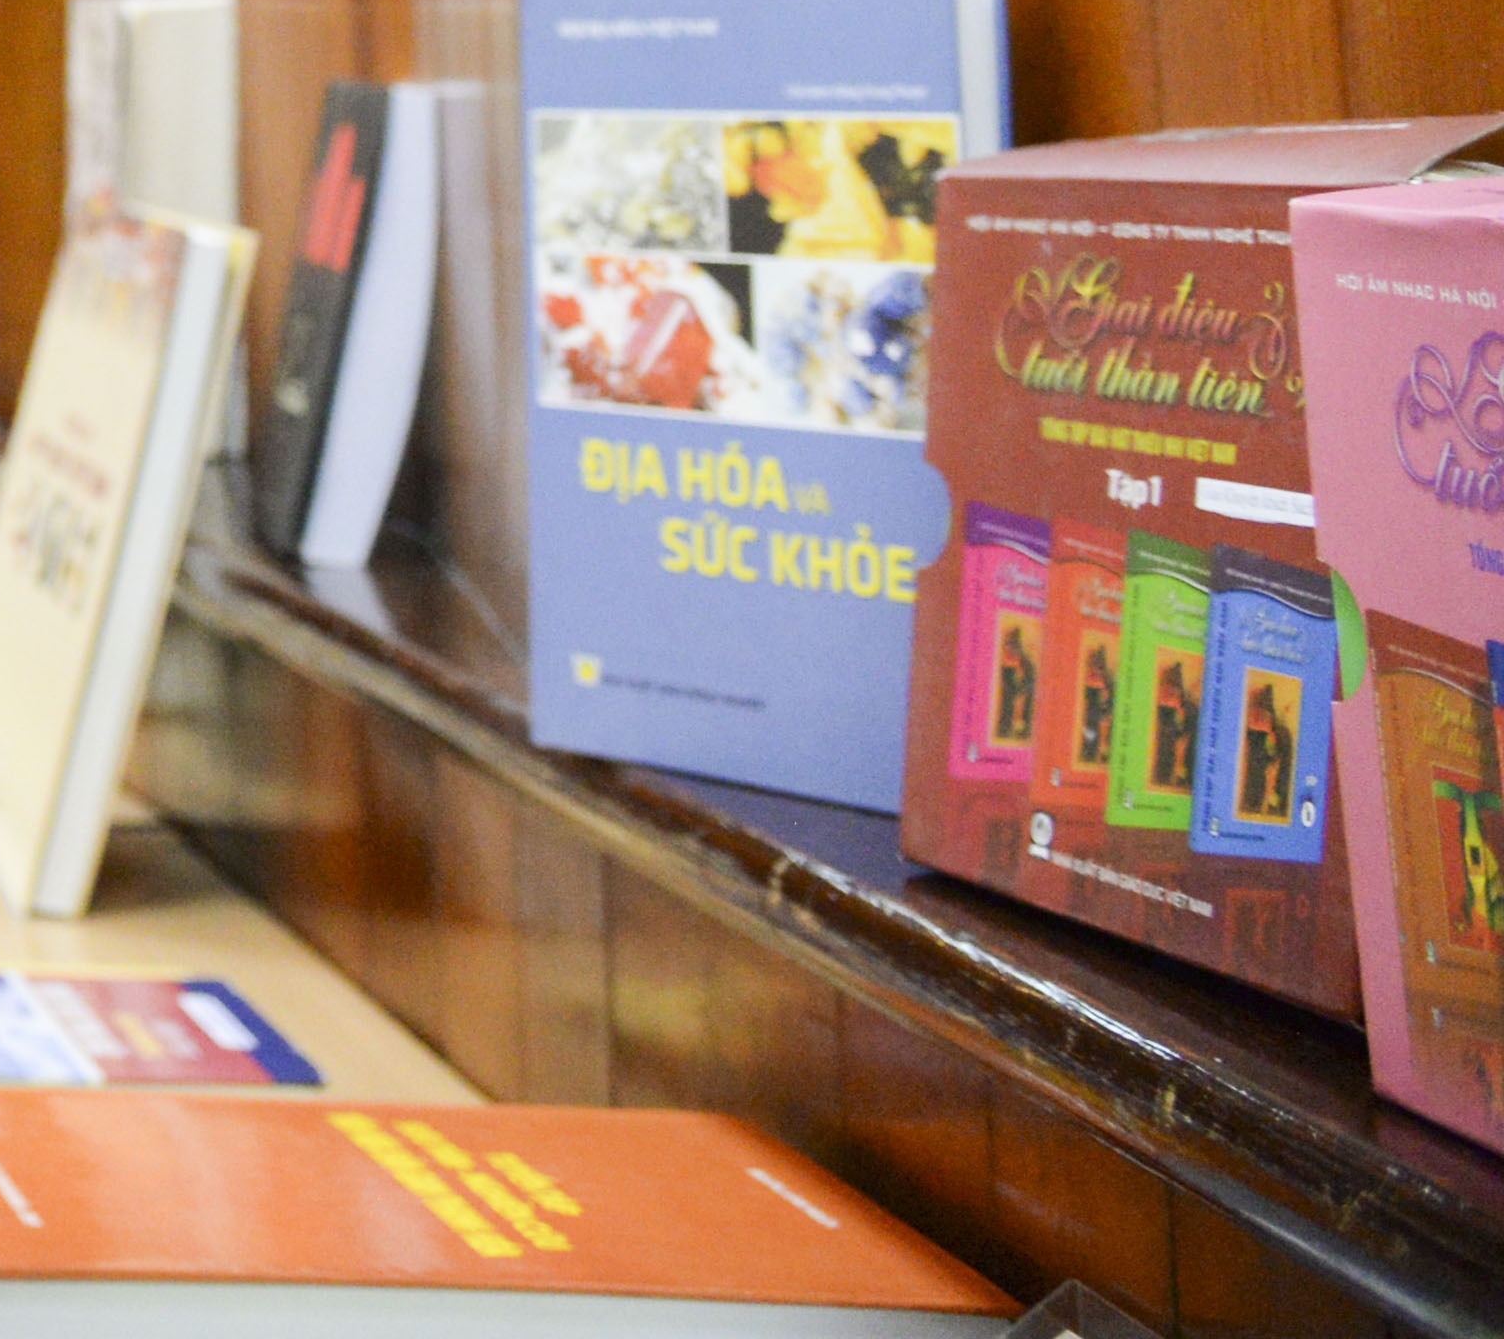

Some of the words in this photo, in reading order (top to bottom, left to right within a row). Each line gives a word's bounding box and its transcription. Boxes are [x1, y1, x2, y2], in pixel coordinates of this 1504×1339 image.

[578, 436, 670, 505] ĐỊA
[677, 439, 791, 514] HÓA
[1105, 468, 1149, 510] Tập
[659, 510, 759, 583] SỨC
[769, 523, 918, 604] KHỎE
